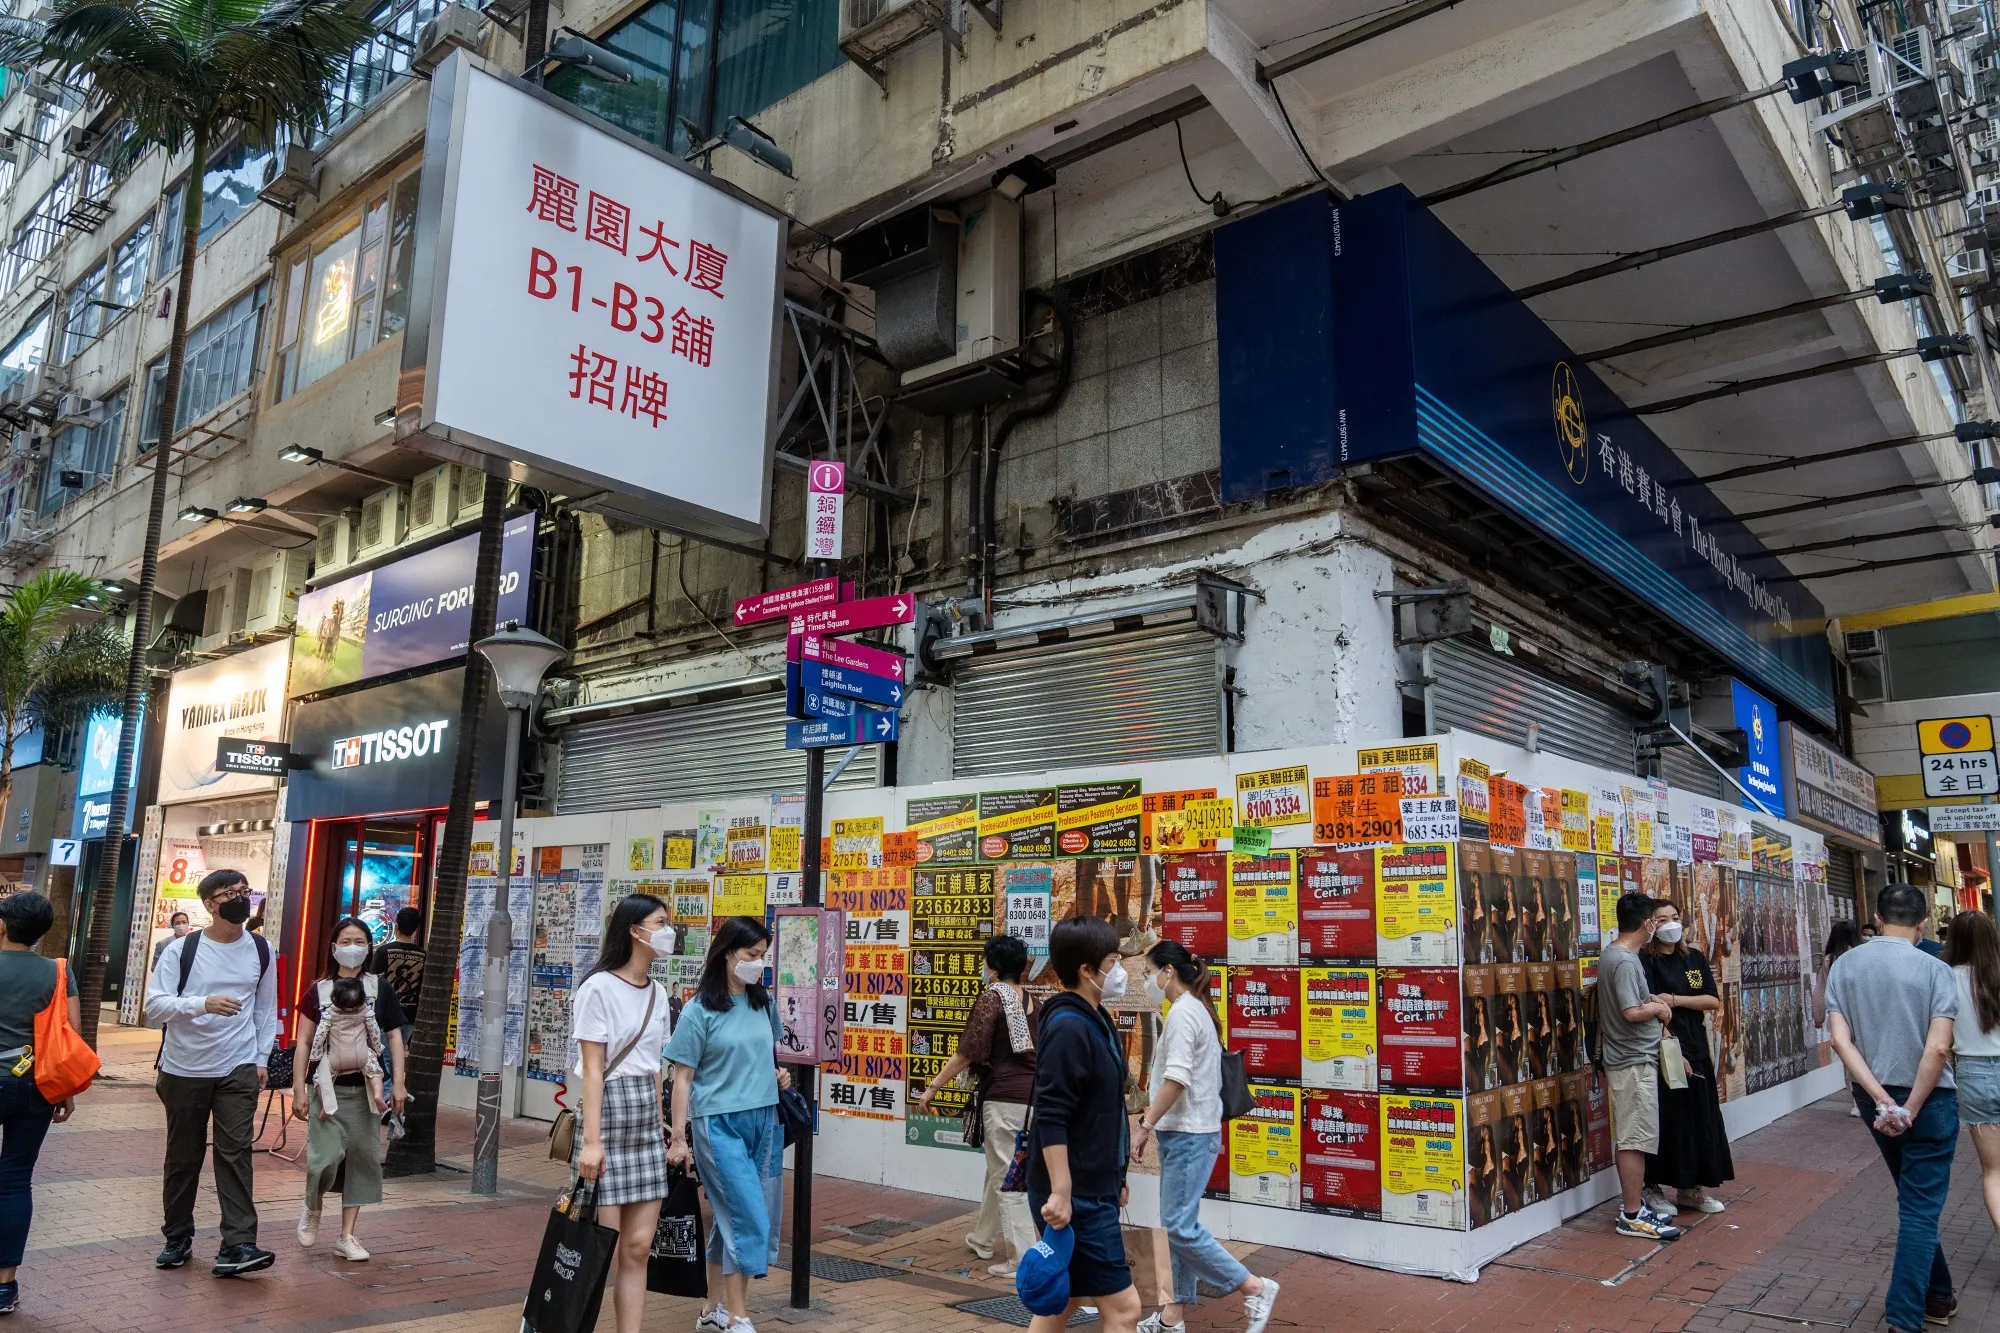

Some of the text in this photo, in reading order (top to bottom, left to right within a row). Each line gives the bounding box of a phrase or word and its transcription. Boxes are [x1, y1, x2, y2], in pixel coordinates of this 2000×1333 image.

[526, 164, 729, 300] 麗園大廈
[527, 246, 715, 368] B1-B3舖
[568, 343, 669, 429] 招牌
[1597, 432, 1682, 538] 香港賽馬會
[814, 495, 837, 556] 銅鑼灣
[1688, 513, 1792, 633] The Hong Kong Jockey Club
[373, 598, 434, 633] SURGING
[807, 609, 837, 624] 時代廣場
[807, 619, 850, 632] Times Square
[821, 640, 837, 652] 利園
[822, 650, 869, 669] The Lee Gardens
[821, 678, 863, 693] Leighton Road
[181, 687, 268, 730] YANNEX MASK
[361, 719, 448, 765] TISSOT
[802, 732, 846, 744] Hennessy Road
[226, 752, 283, 767] TISSOT
[1382, 746, 1435, 763] 美聯旺舖
[1931, 757, 1988, 771] 24 hrs
[1258, 768, 1306, 786] 美聯旺舖
[1461, 776, 1484, 793] 劉先生
[1939, 774, 1984, 792] 全日
[1247, 787, 1293, 801] 劉先生
[1315, 775, 1400, 798] 旺舖招租
[1247, 795, 1301, 820] 8100 3334
[1335, 798, 1380, 819] 黃生
[1402, 799, 1457, 814] 業主放盤
[1944, 807, 1970, 815] Except
[731, 816, 761, 828] 旺舖租售
[981, 810, 1054, 832] Professional Postering Services
[1058, 802, 1139, 827] Professional Postering Services
[1186, 806, 1233, 831] 93419313
[1936, 814, 1951, 822] pick
[1954, 813, 1983, 821] up/drop
[934, 815, 975, 831] Postering Services
[1315, 818, 1402, 840] 9381-2901
[740, 827, 765, 839] 美聯旺舖
[1431, 823, 1458, 839] 5434
[1018, 844, 1052, 853] 9402 6503
[1100, 838, 1136, 848] 9402 6503
[1235, 836, 1266, 847] 95553591
[833, 853, 855, 867] 2787
[883, 850, 916, 863] 9277 9943
[1097, 859, 1135, 871] LANE EIGHT
[1316, 862, 1339, 874] 專業
[845, 871, 907, 887] 御峯旺舖
[935, 872, 992, 895] 旺舖專家
[684, 884, 709, 894] 美聯旺舖
[724, 878, 749, 896] 國金行
[1313, 885, 1351, 899] Cert. in
[832, 888, 906, 912] 2391 8028
[1012, 897, 1043, 910] 余其禧
[1174, 890, 1207, 902] Cert. in
[916, 898, 991, 915] 23662833
[1009, 909, 1047, 920] 8300 0648
[937, 928, 973, 939] 歡迎委託
[1009, 925, 1034, 938] 租/售
[867, 972, 904, 996] 8028
[1245, 980, 1267, 993] 專業
[1397, 983, 1421, 997] 專業
[1242, 1006, 1279, 1017] Cert. in
[1394, 1011, 1435, 1023] Cert. in
[1119, 1015, 1136, 1026] EIGHT
[865, 1055, 902, 1080] 8028
[830, 1082, 896, 1110] 租/售
[1320, 1104, 1343, 1119] 專業
[1317, 1132, 1355, 1144] Cert. in
